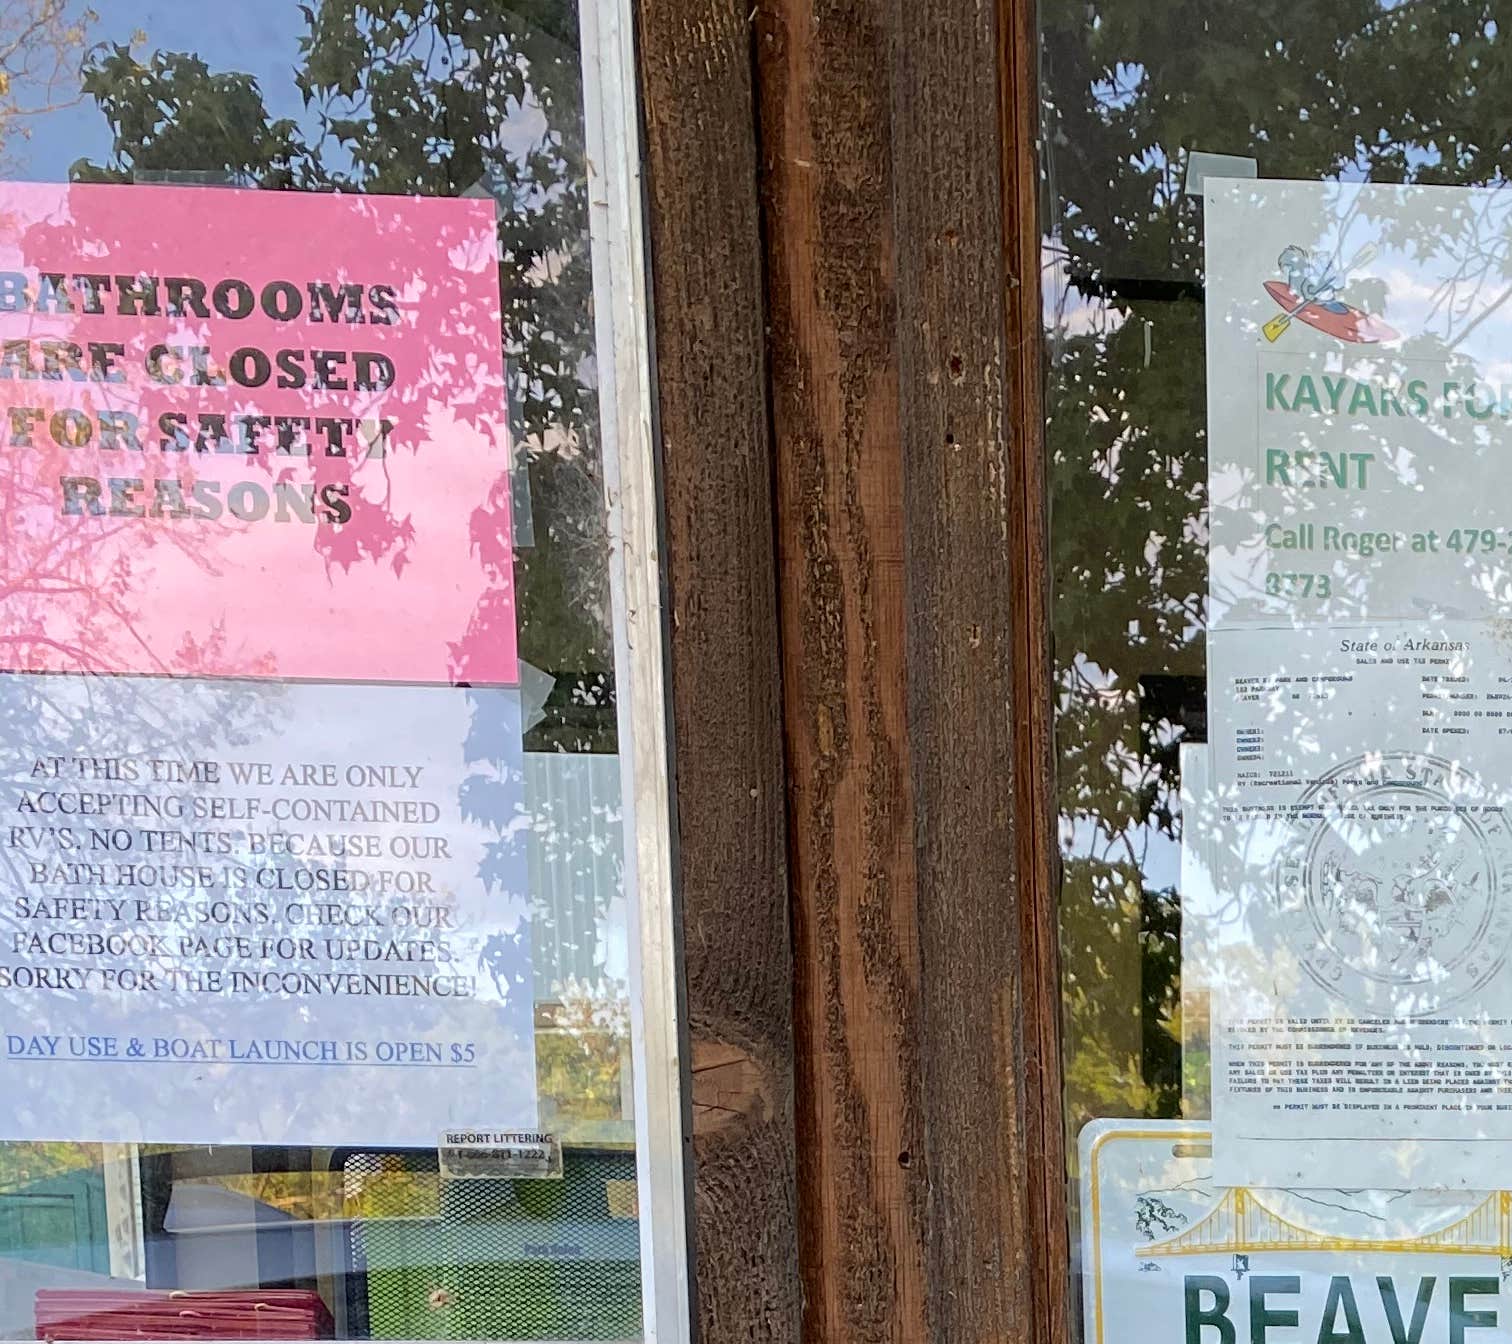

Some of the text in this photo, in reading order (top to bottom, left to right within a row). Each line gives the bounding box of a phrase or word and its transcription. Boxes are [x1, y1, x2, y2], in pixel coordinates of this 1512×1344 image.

[0, 271, 401, 326] BATHROOMS
[0, 339, 395, 393] ARE CLOSED
[1265, 372, 1428, 417] KAYAKS
[7, 407, 394, 458] FOR SAFETY
[1266, 448, 1375, 489] RENT
[60, 475, 352, 525] REASONS
[1265, 523, 1314, 552] Call
[1411, 529, 1441, 552] at
[1340, 639, 1377, 652] State
[1403, 638, 1471, 652] Arkansas
[31, 757, 424, 788] AT THIS TIME WE ARE ONLY
[16, 791, 440, 824] ACCEPTING SELF-CONTAINED
[8, 826, 452, 859] RV'S. NO TENTS. BECAUSE OUR
[30, 862, 434, 893] BATH HOUSE IS CLOSED FOR
[15, 896, 455, 928] SAFETY REASONS. CHECK OUR
[12, 931, 460, 962] FACEBOOK PAGE FOR UPDATES.
[0, 966, 476, 997] SORRY FOR THE INCONVENIENCE!
[7, 1036, 475, 1064] DAY USE & BOAT LAUNCH IS OPEN $5
[446, 1134, 553, 1144] REPORT LITTERING
